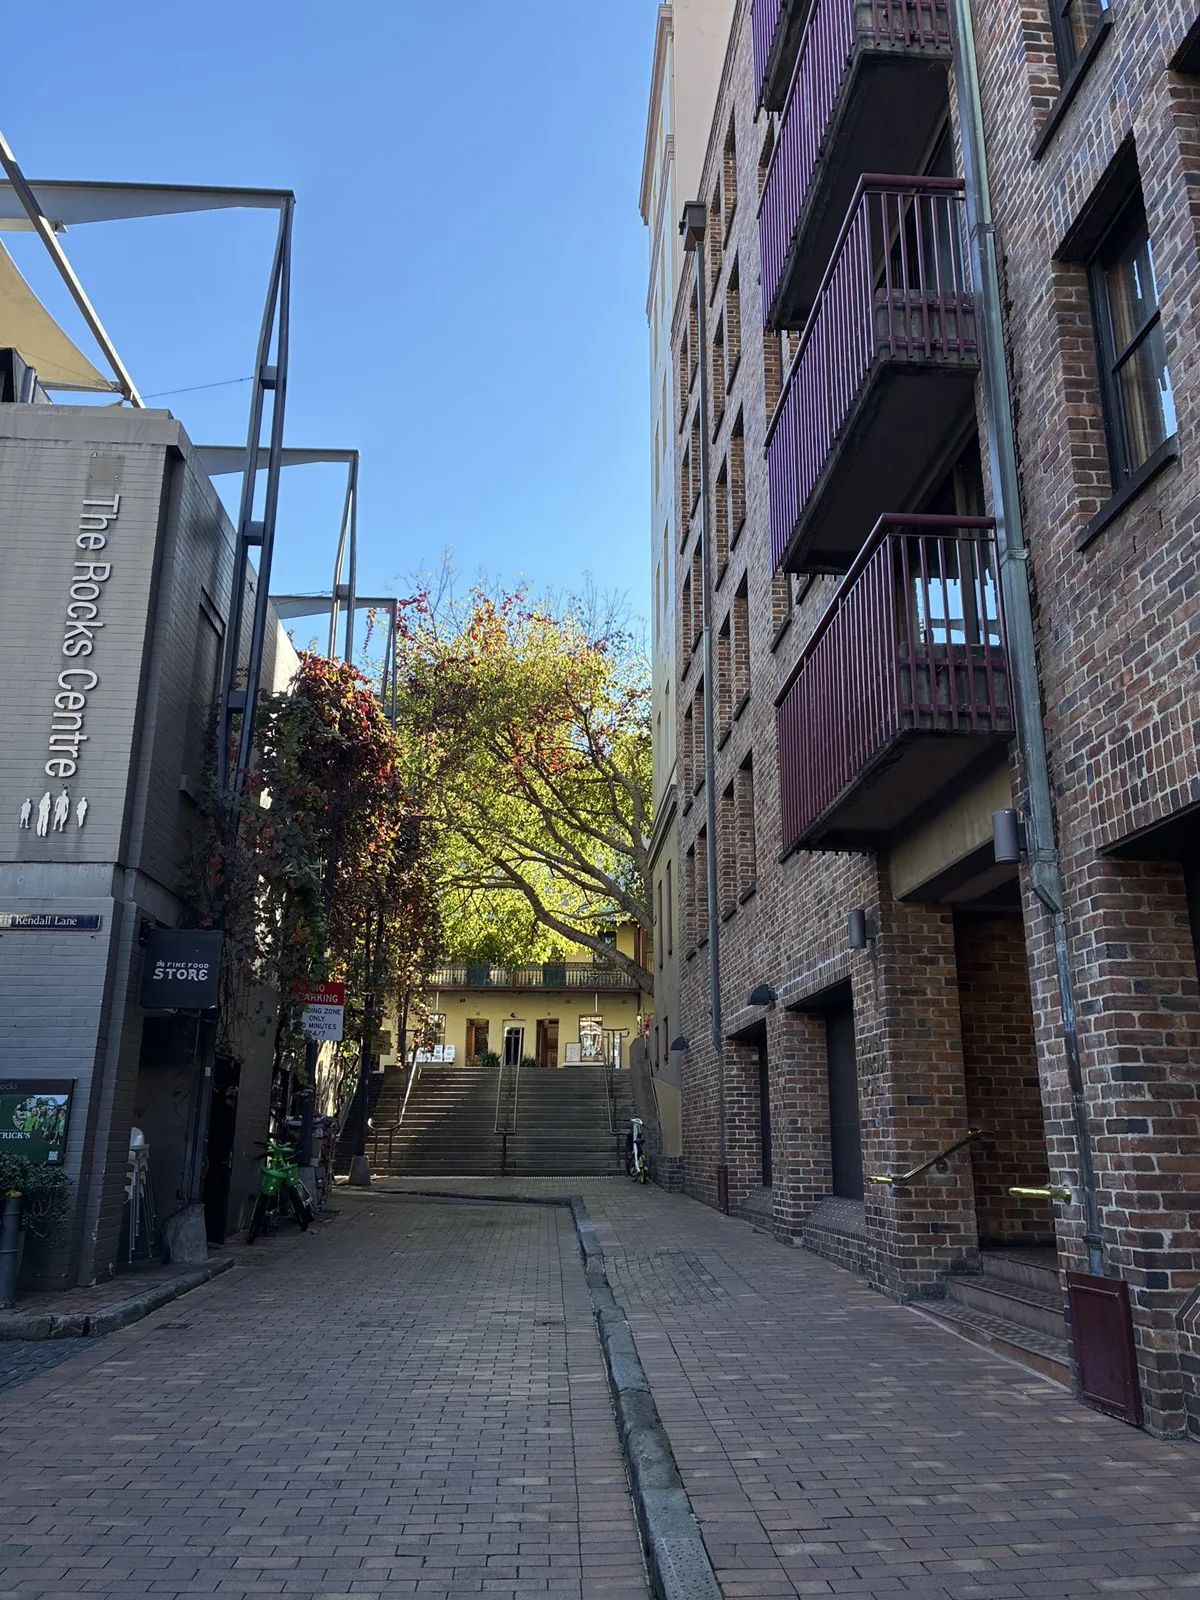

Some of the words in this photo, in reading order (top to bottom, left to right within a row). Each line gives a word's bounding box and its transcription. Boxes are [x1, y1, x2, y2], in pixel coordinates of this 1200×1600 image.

[76, 493, 120, 550] The
[62, 561, 111, 657] Rocks
[44, 668, 99, 778] Centre
[15, 915, 51, 925] Kendall
[54, 916, 78, 926] Lane
[153, 968, 208, 981] STORE
[303, 993, 338, 1003] ARKING
[309, 1022, 337, 1030] MINUTES
